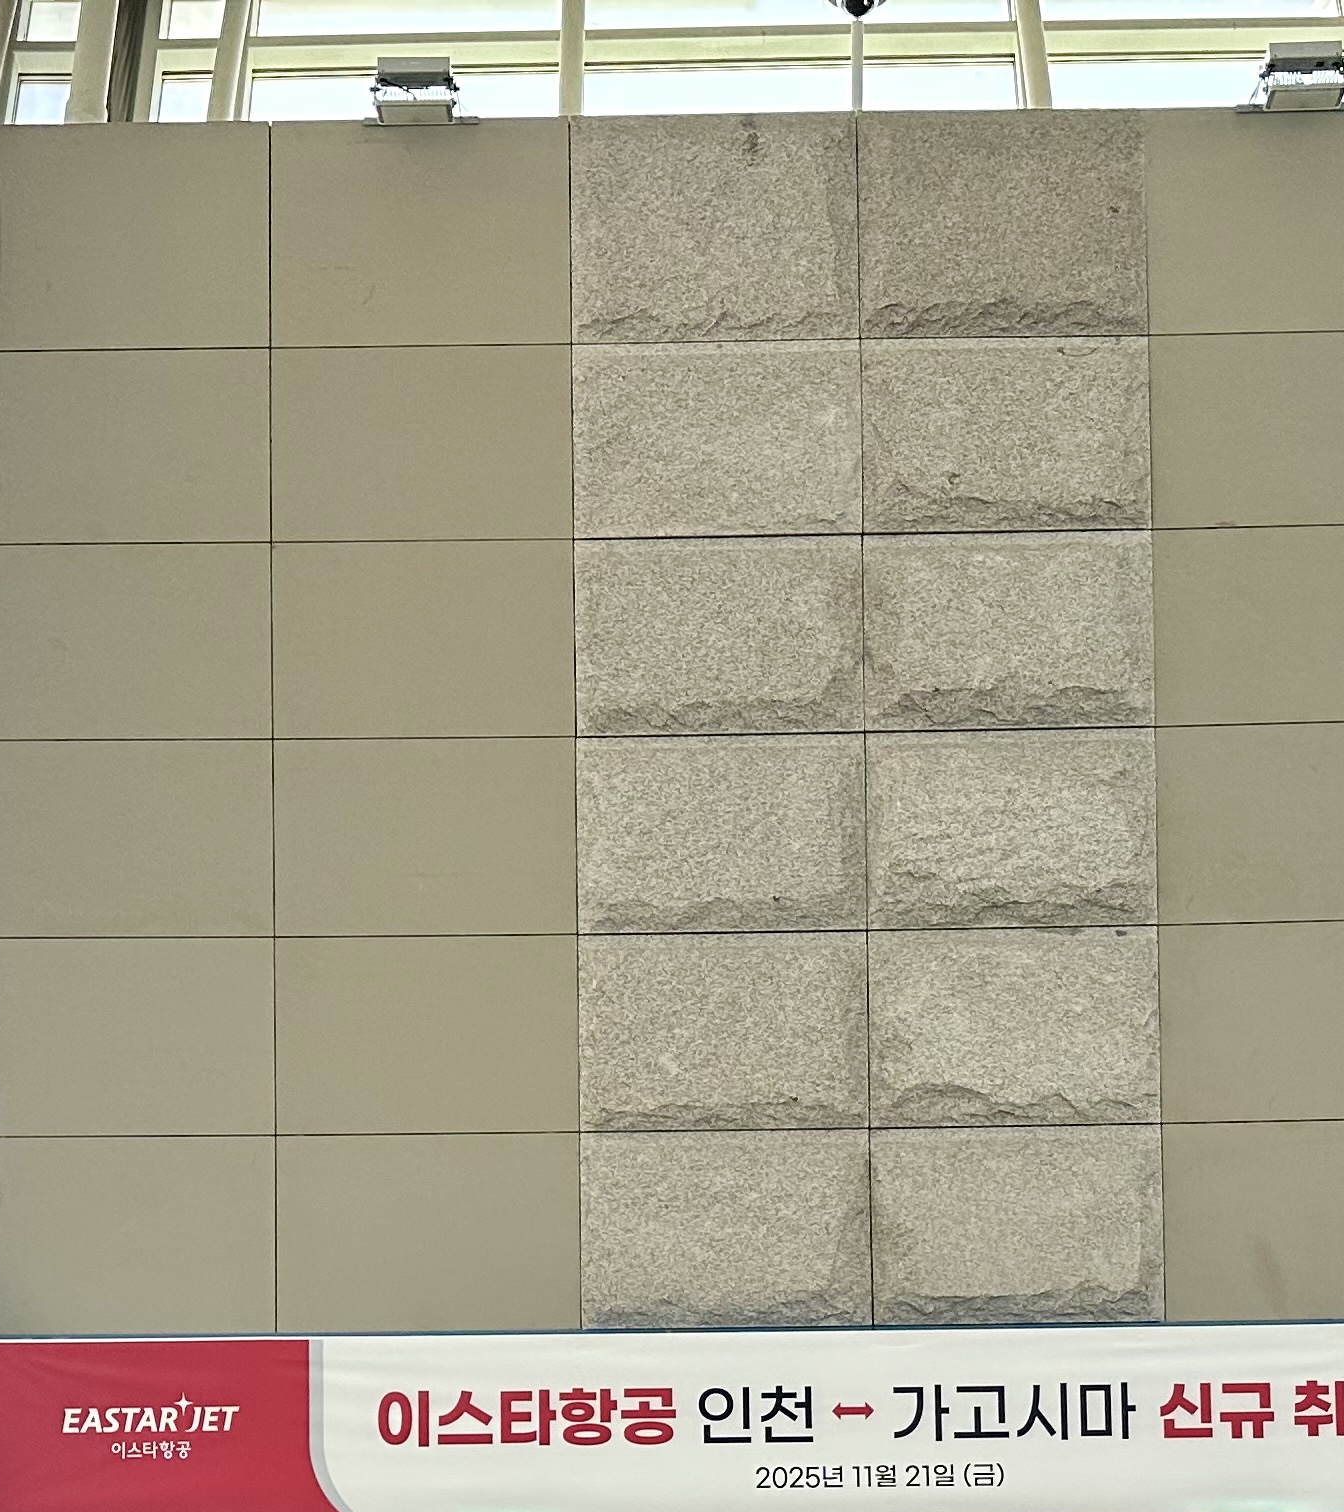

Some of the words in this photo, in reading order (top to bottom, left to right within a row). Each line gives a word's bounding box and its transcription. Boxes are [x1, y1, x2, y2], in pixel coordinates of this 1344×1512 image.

[377, 1387, 677, 1448] 이스타항공
[698, 1385, 814, 1444] 인천
[892, 1381, 1137, 1442] 가고시마
[1159, 1382, 1275, 1439] 신규
[111, 1440, 192, 1460] 이스타항공
[755, 1465, 844, 1489] 2025년
[851, 1464, 897, 1488] 11월
[905, 1463, 955, 1487] 21일
[963, 1462, 1005, 1488] (금)
